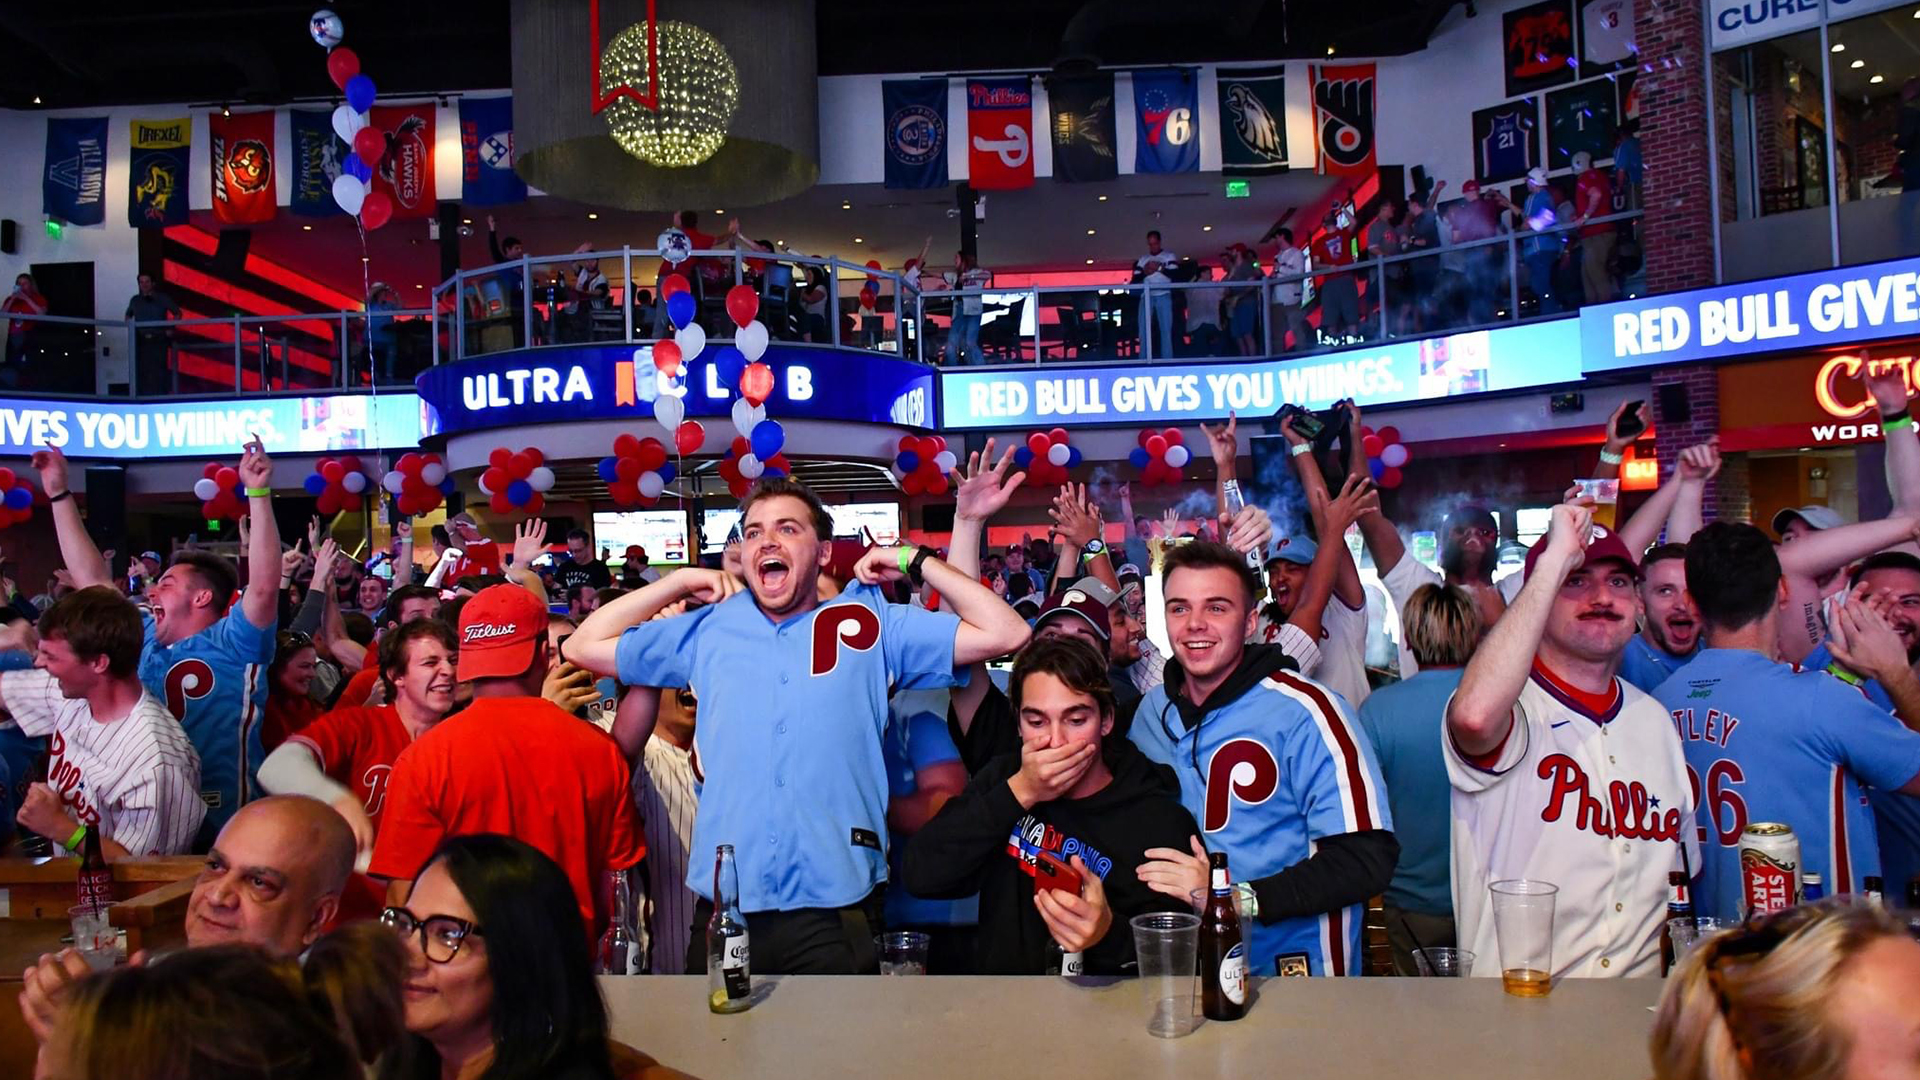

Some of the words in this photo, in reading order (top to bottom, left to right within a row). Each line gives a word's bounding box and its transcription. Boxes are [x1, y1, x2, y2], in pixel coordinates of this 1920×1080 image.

[1608, 11, 1618, 28] 3
[969, 83, 1029, 106] Phillies
[138, 125, 183, 144] DREXEL
[1058, 112, 1070, 145] WINGS
[1144, 107, 1191, 148] 76
[1498, 131, 1515, 149] 21
[1575, 110, 1584, 132] 1
[402, 143, 415, 199] HAWKS
[462, 120, 479, 181] PENN
[76, 138, 102, 205] VILLANOVA
[1613, 306, 1690, 357] RED
[1699, 290, 1800, 347] BULL
[1808, 271, 1920, 332] GIVE
[463, 364, 594, 410] ULTRA
[658, 363, 814, 400] CLB
[970, 380, 1028, 417] RED
[1036, 377, 1106, 415] BULL
[1112, 374, 1201, 413] GIVES
[1206, 371, 1275, 411] YOU
[75, 411, 149, 448] YOU
[464, 622, 517, 643] Titleist
[810, 602, 882, 678] P
[1686, 689, 1713, 699] Jeep
[1671, 707, 1740, 749] TLEY
[1203, 737, 1280, 834] P
[1537, 753, 1681, 844] Phillie
